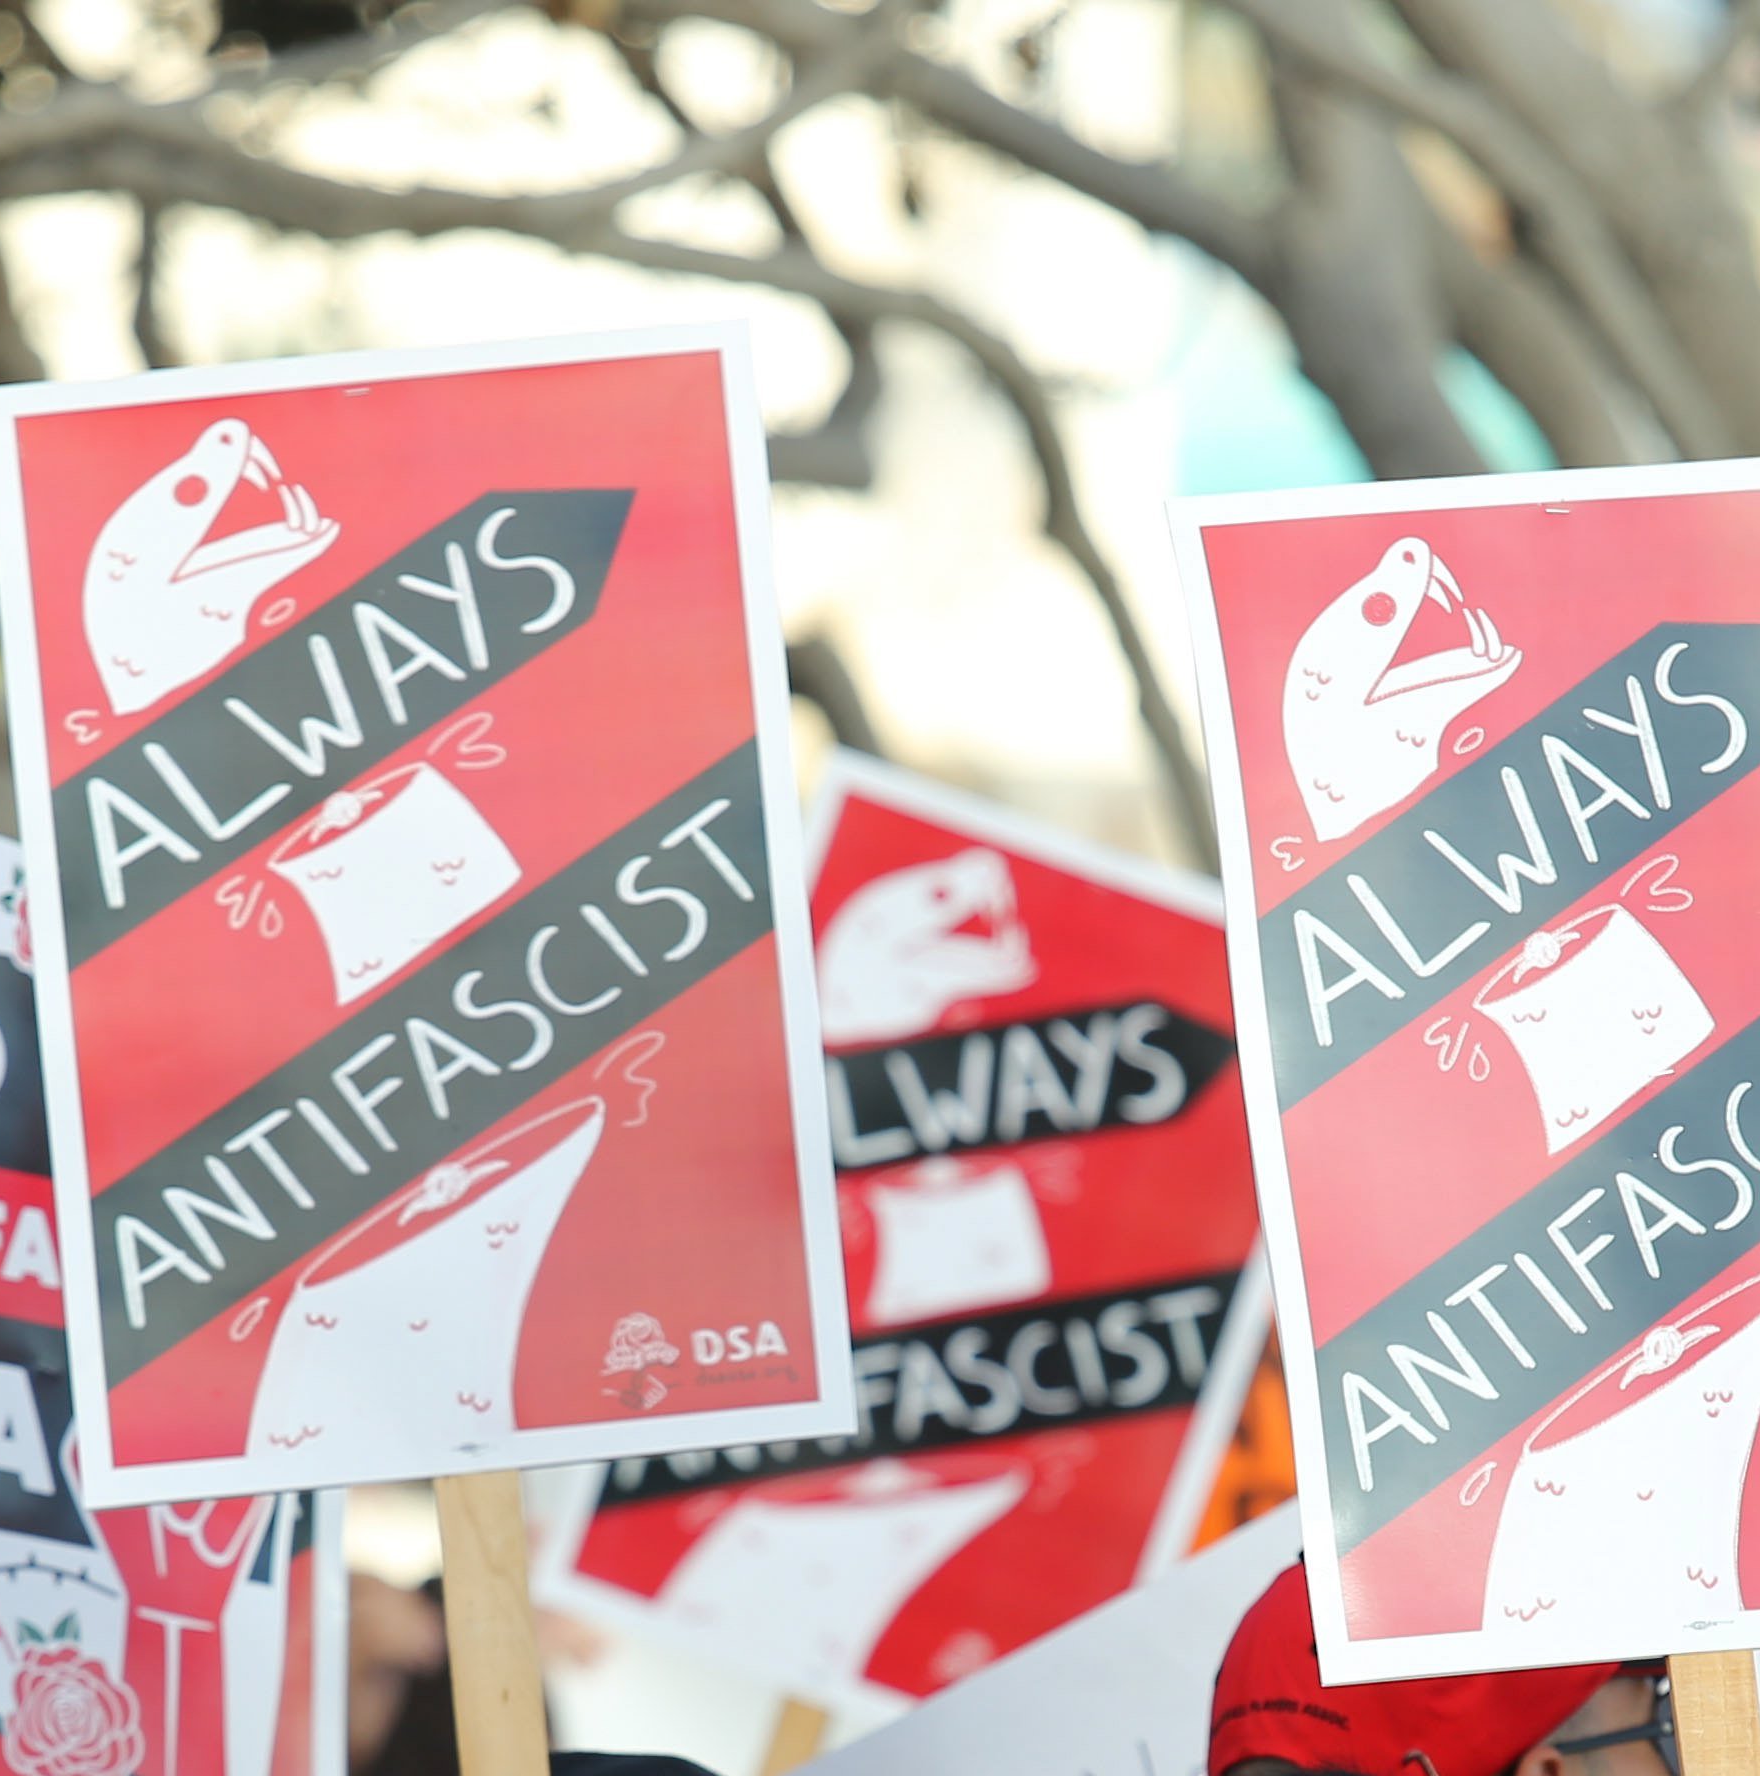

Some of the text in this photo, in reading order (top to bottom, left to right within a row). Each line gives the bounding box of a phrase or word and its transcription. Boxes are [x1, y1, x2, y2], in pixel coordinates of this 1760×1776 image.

[79, 508, 578, 910] ALWAYS
[1294, 641, 1748, 1048] ALWAYS
[113, 799, 756, 1328] ANTIFASCIST
[826, 1000, 1188, 1168] LWAYS
[690, 1319, 790, 1367] DSA
